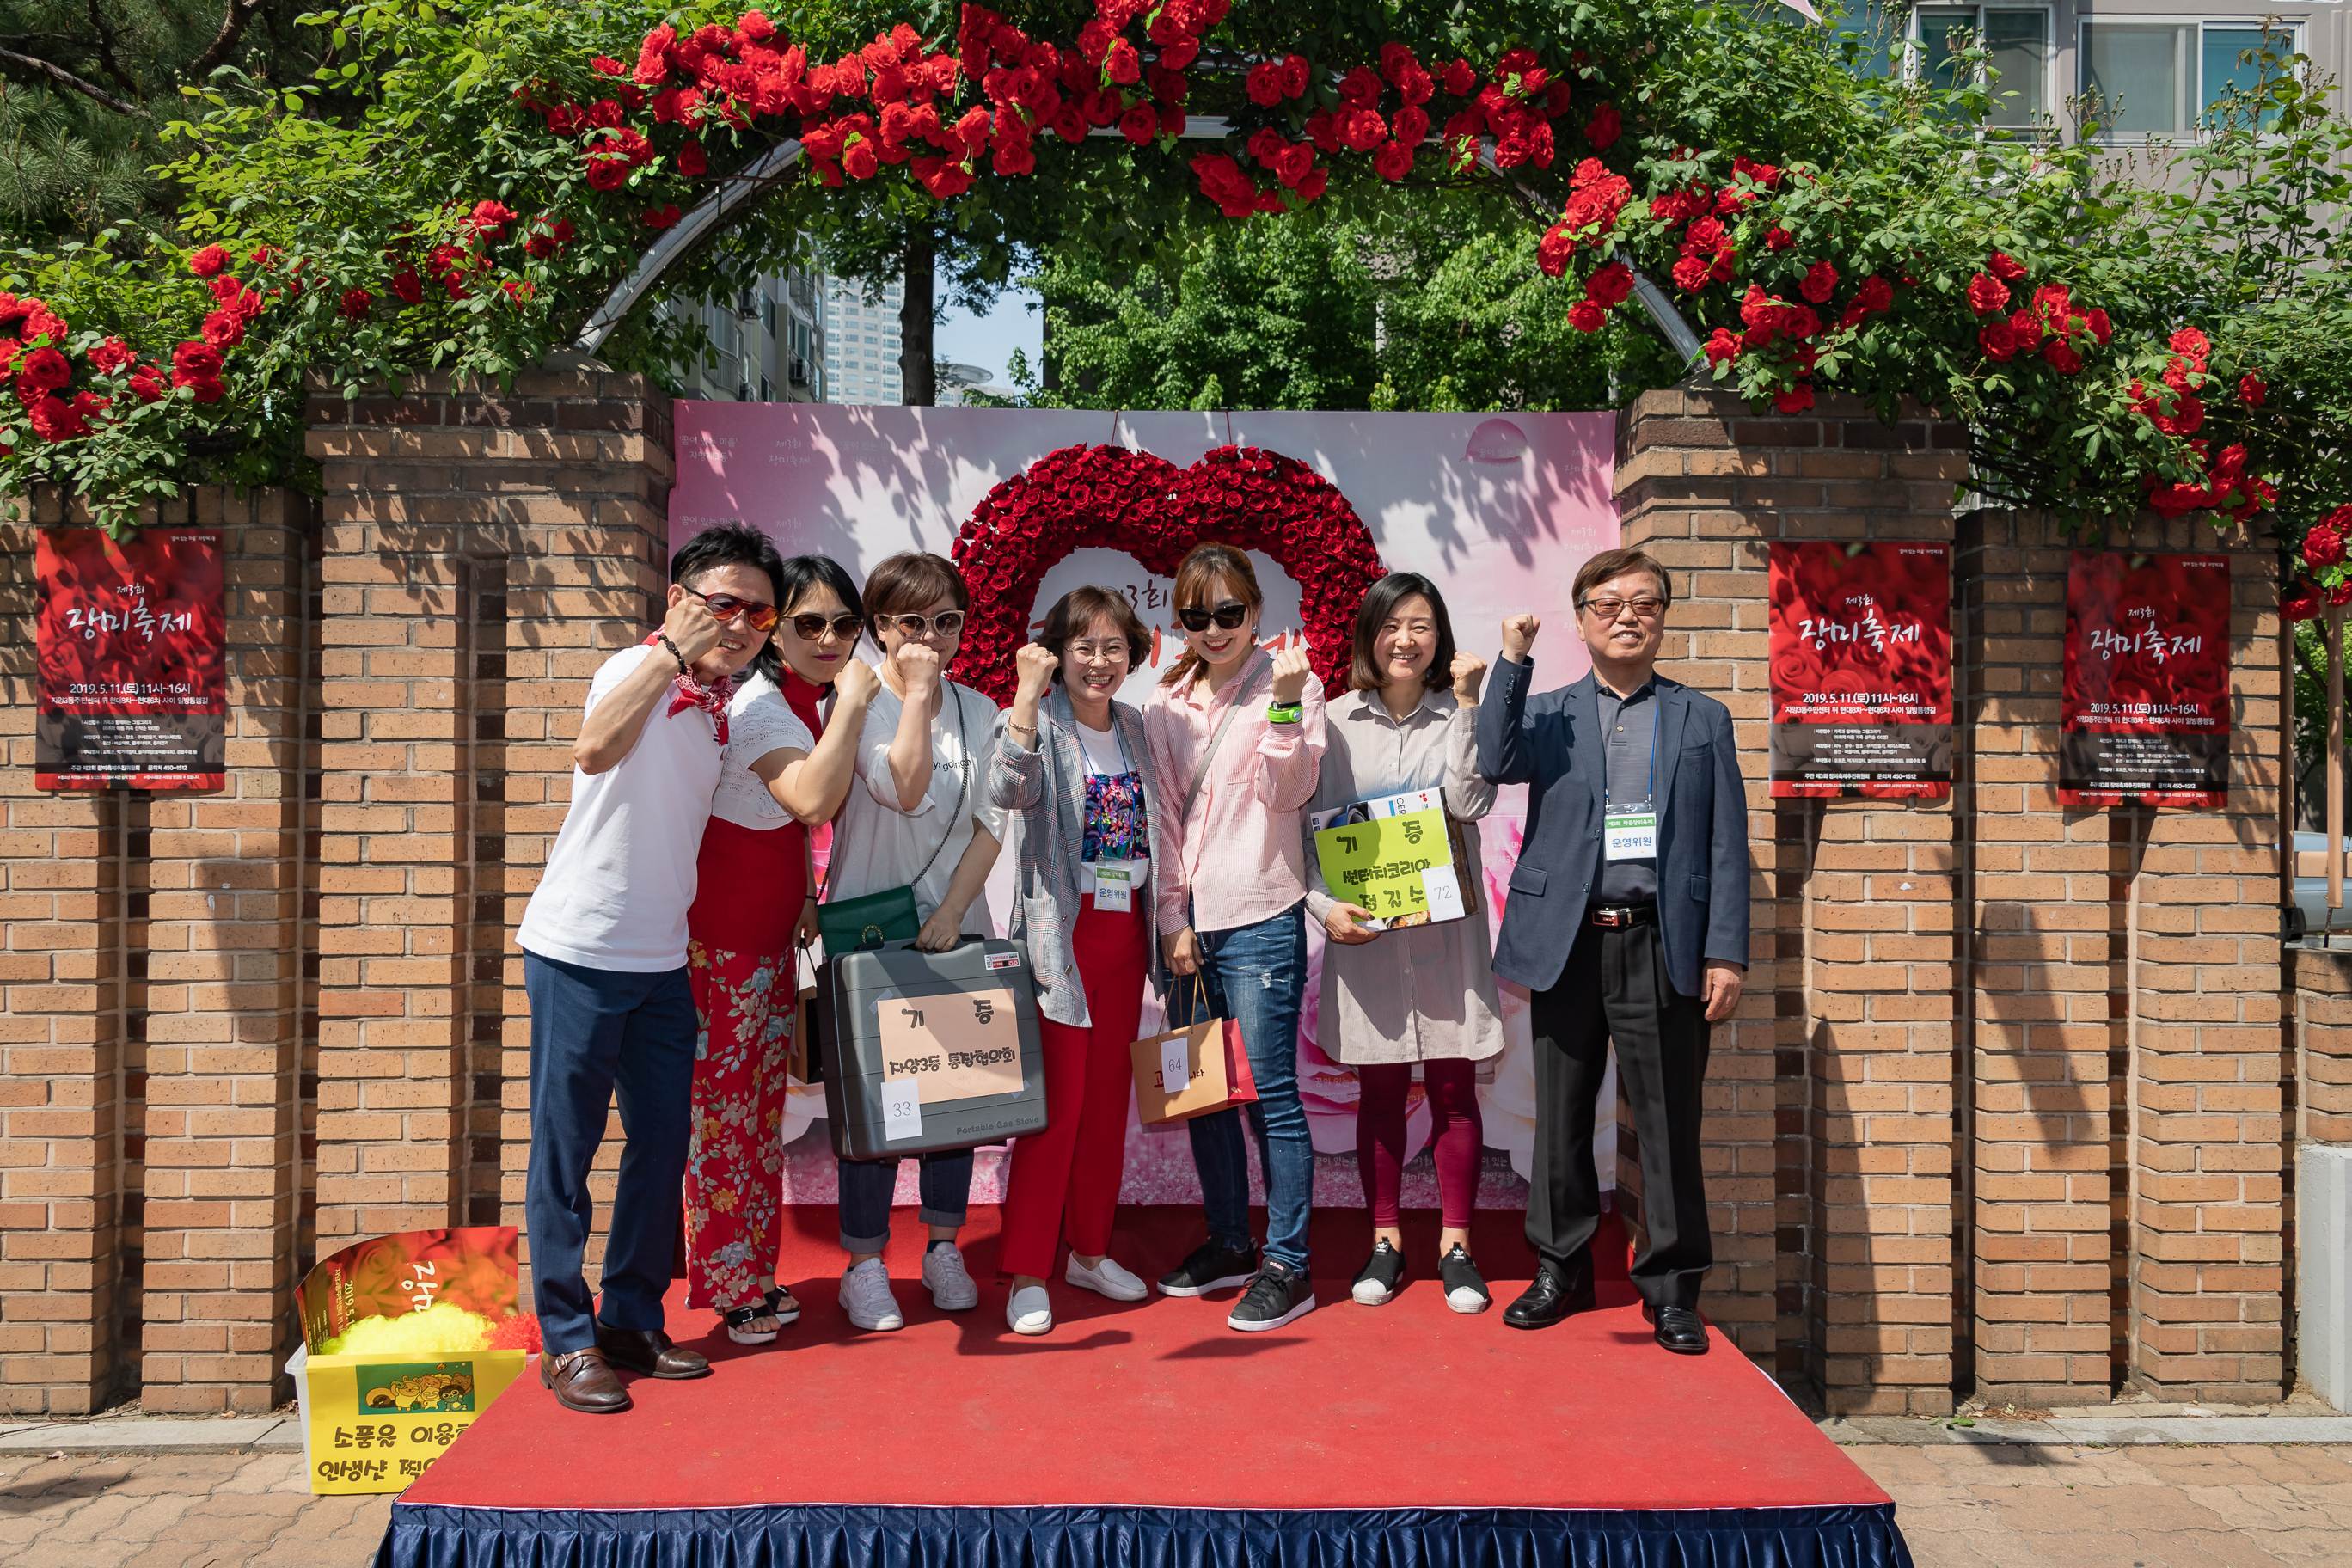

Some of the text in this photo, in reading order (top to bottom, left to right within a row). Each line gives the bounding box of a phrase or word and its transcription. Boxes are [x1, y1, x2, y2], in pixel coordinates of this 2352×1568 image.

[700, 437, 716, 447] 있는
[689, 451, 727, 462] 자양제3동
[769, 452, 810, 467] 장미축제
[117, 582, 144, 596] 제3회
[1121, 579, 1167, 611] 3회
[1845, 593, 1873, 607] 제3회
[66, 597, 192, 642] 장미축제
[2128, 605, 2155, 619] 제3회
[1798, 609, 1920, 653] 장미축제
[2090, 621, 2201, 664] 장미축제
[141, 683, 191, 695] 11시~16시
[162, 696, 175, 705] 사이
[1871, 693, 1919, 705] 11시~16시
[1612, 837, 1652, 848] 운영위원
[1099, 887, 1126, 899] 운영위원
[1434, 885, 1452, 900] 72
[889, 1046, 1016, 1075] 자양3동 통장협의회
[1168, 1057, 1182, 1073] 64
[892, 1101, 911, 1118] 33
[956, 1116, 1040, 1135] Portable Gas Stove
[1269, 1261, 1284, 1271] adidas
[334, 1424, 397, 1448] 소품을
[318, 1459, 387, 1482] 인생샷
